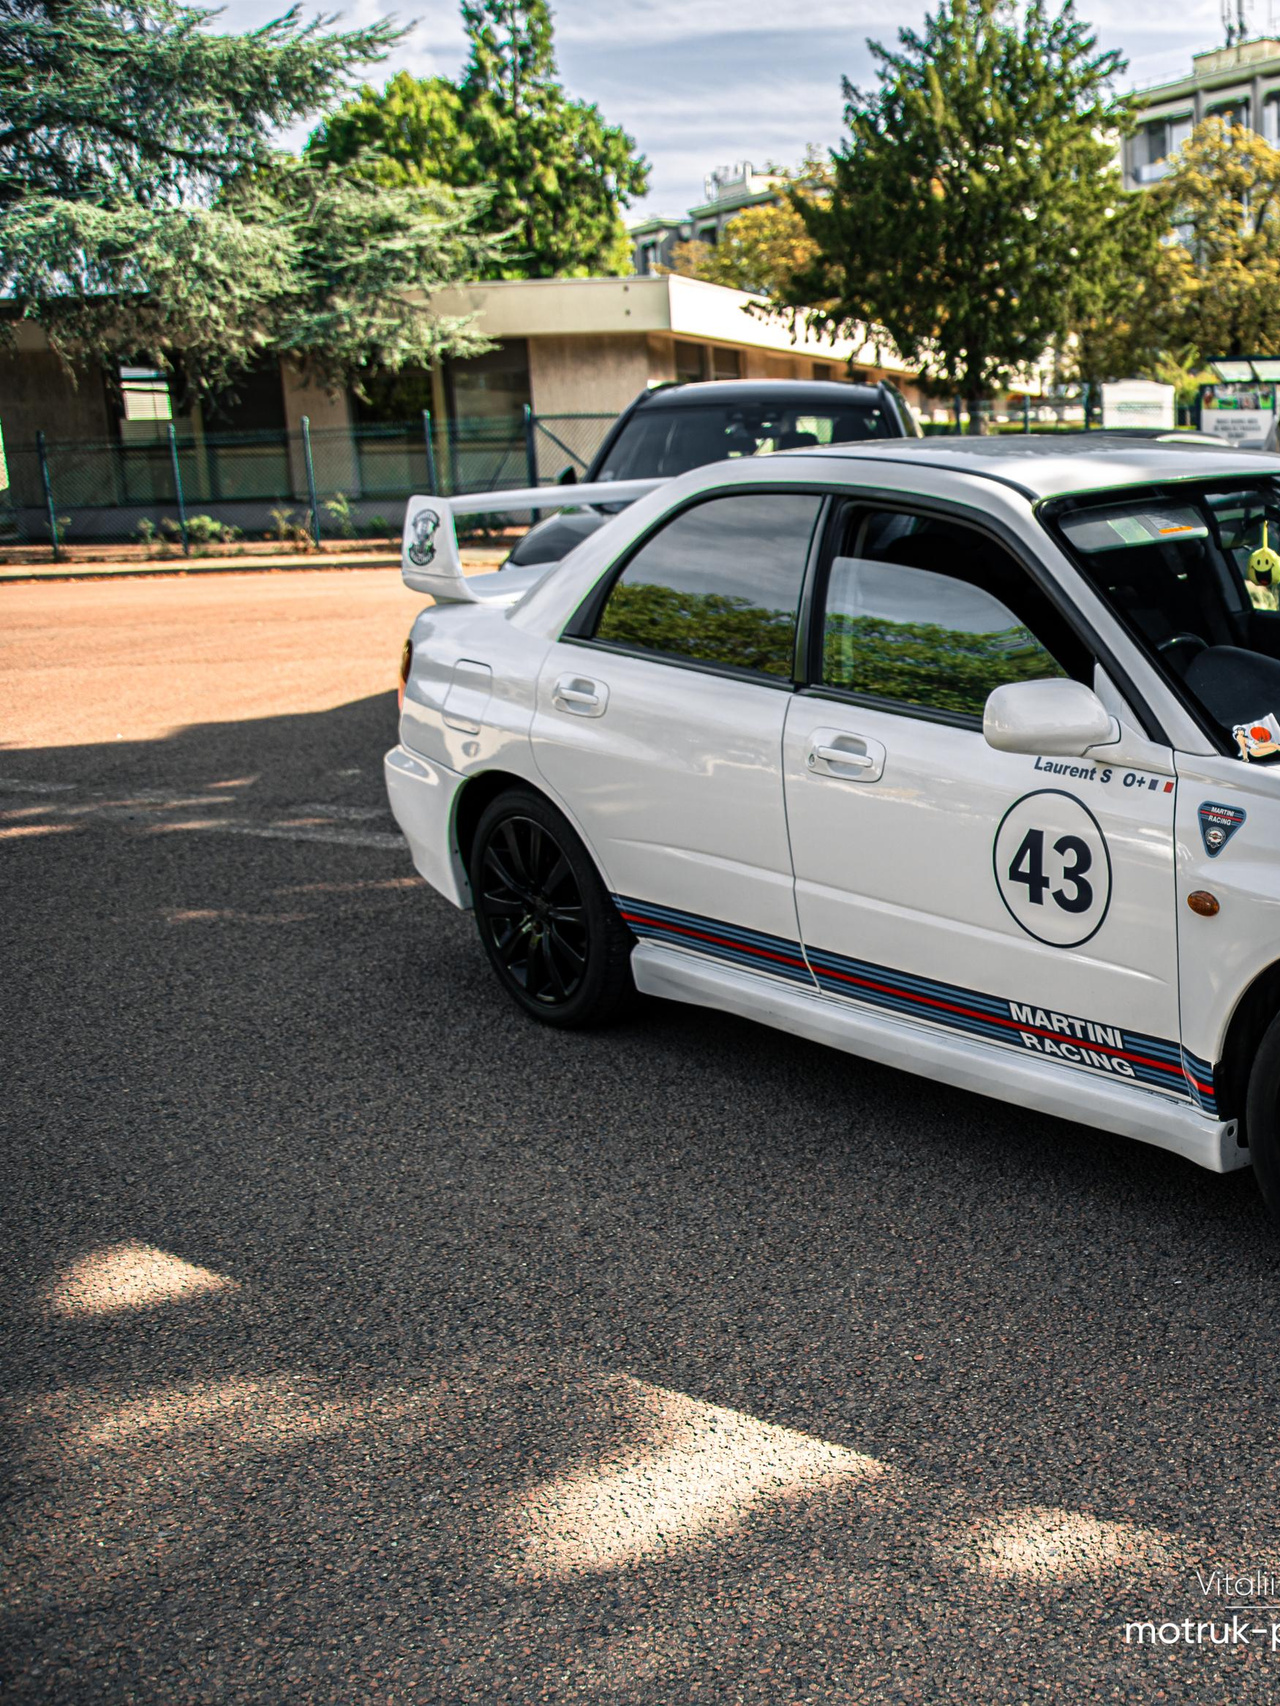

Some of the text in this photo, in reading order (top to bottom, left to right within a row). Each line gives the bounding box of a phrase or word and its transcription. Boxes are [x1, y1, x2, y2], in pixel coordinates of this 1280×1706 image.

[1034, 756, 1097, 781] Laurent
[1100, 768, 1113, 784] S
[1208, 814, 1232, 826] RACING
[1210, 806, 1236, 818] MARTINI
[1008, 828, 1093, 914] 43
[1009, 1001, 1124, 1050] MARTINI
[1019, 1030, 1136, 1077] RACING
